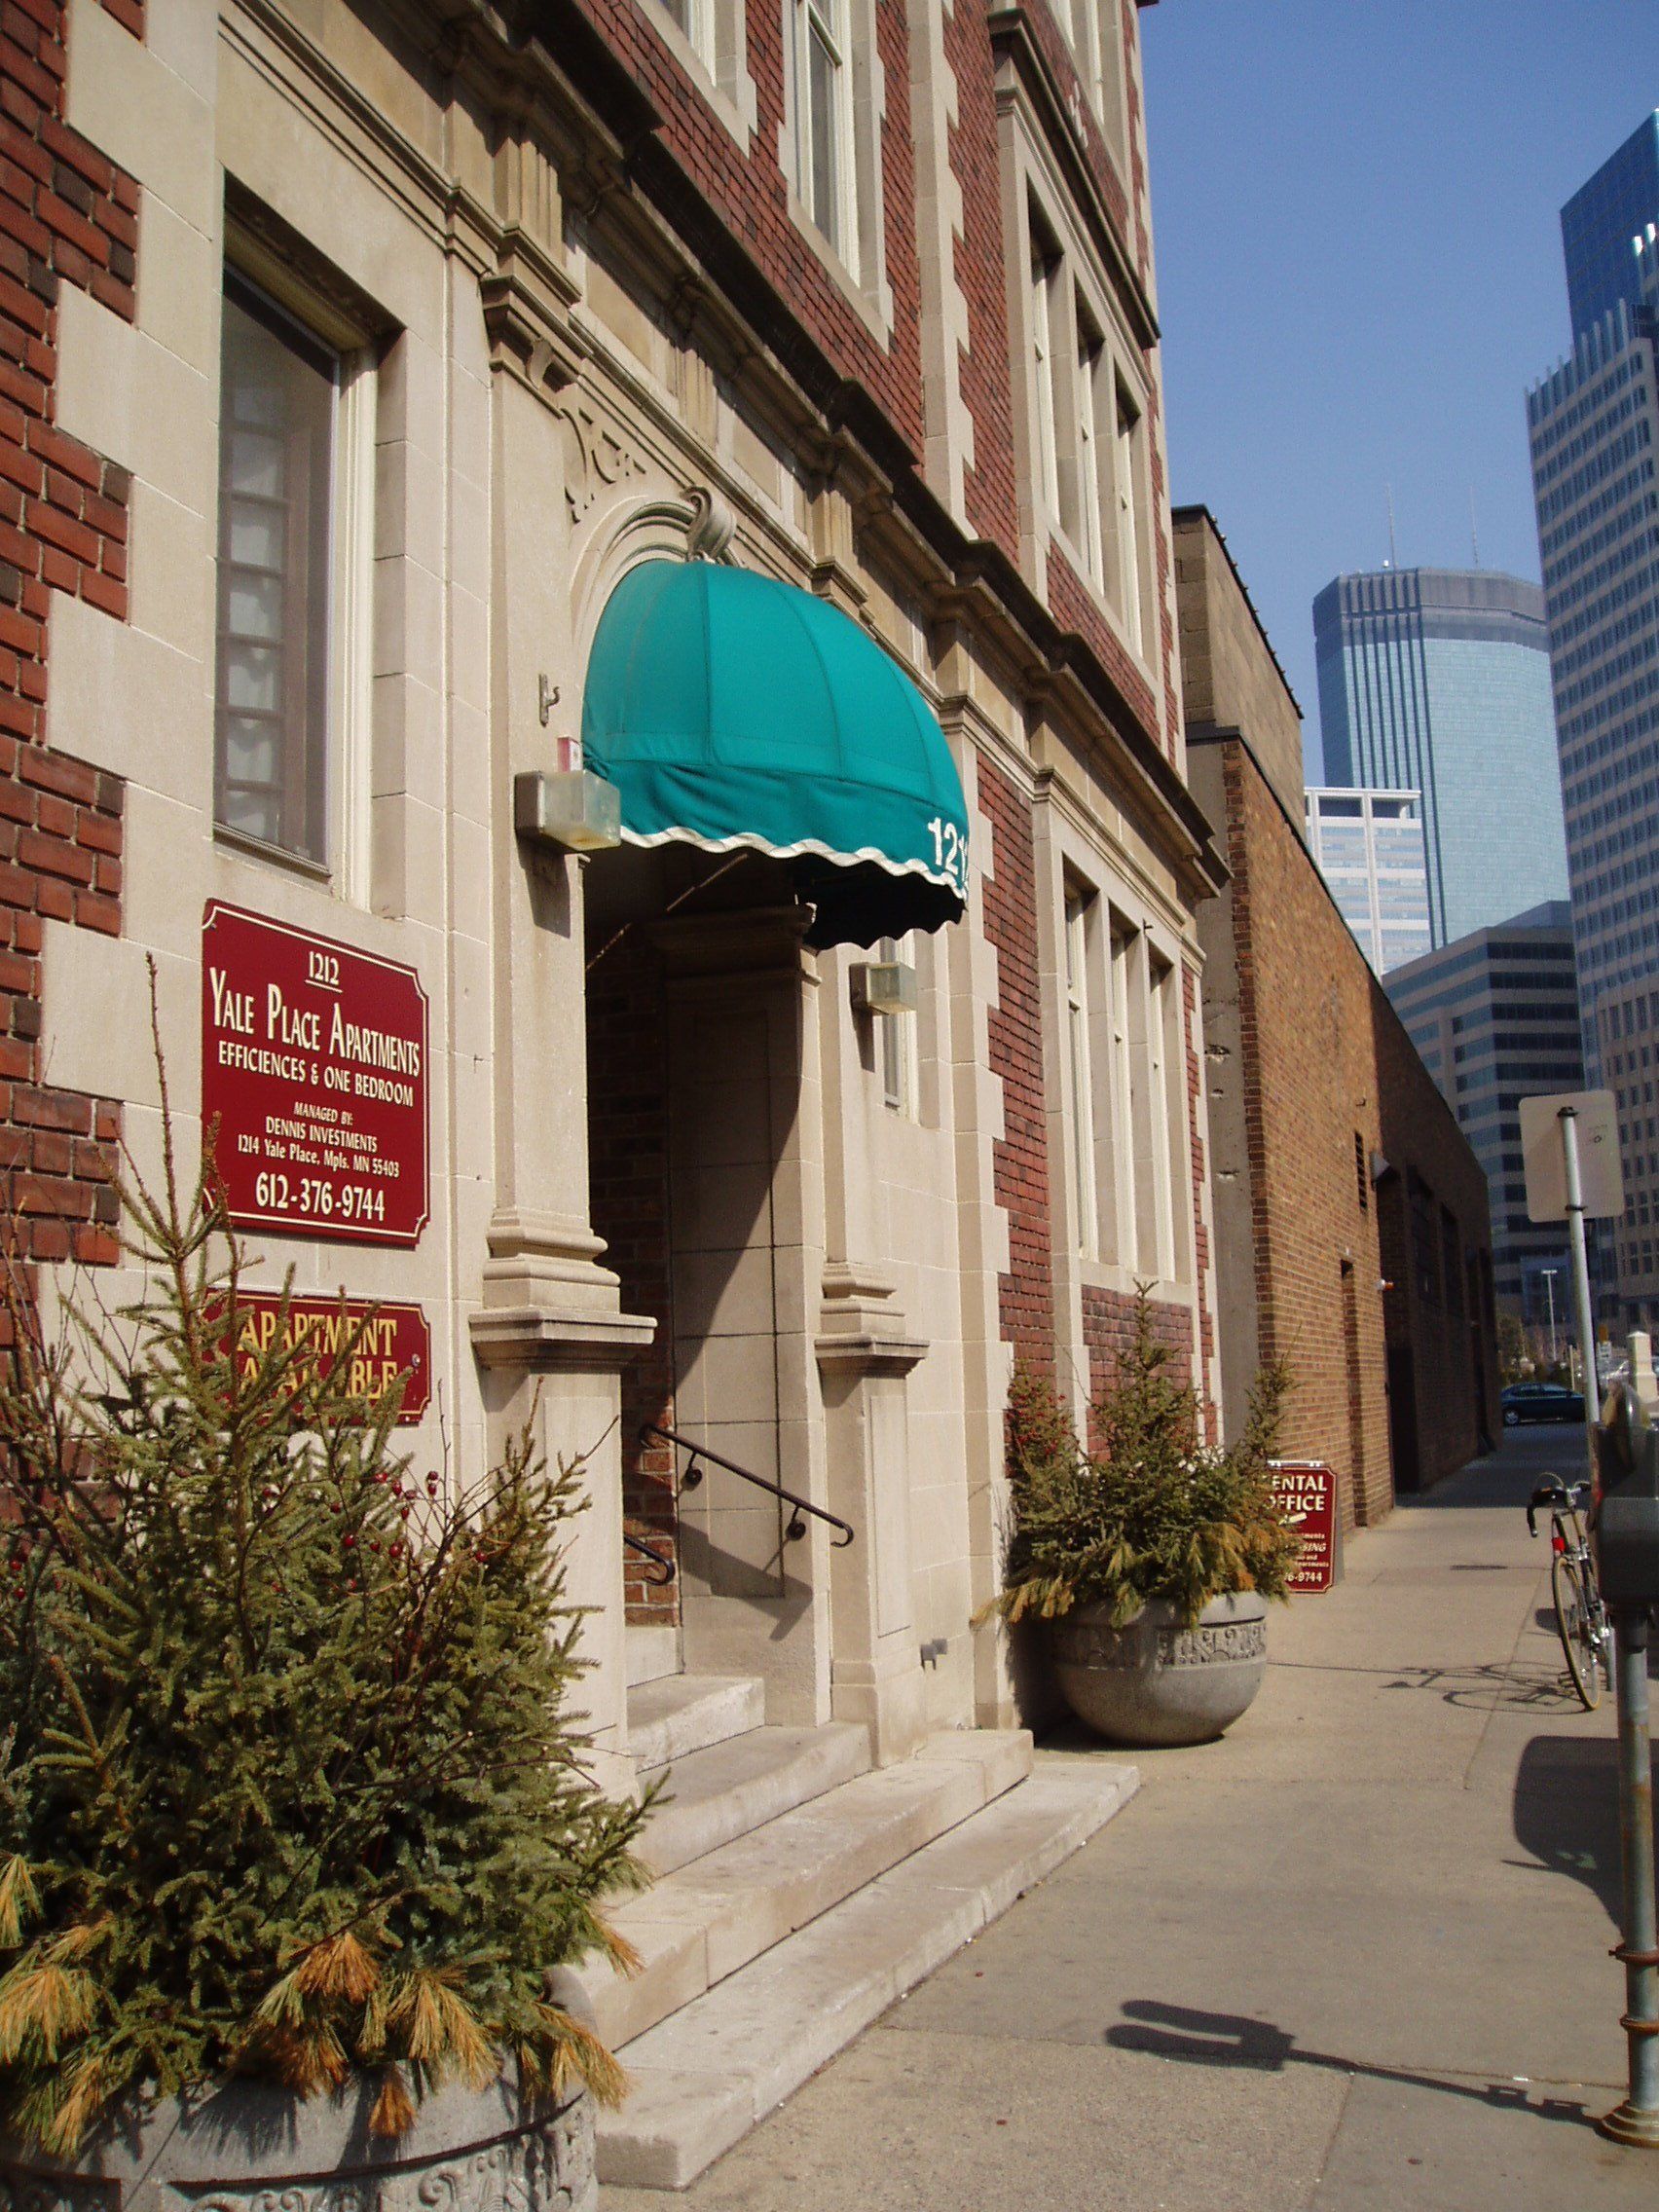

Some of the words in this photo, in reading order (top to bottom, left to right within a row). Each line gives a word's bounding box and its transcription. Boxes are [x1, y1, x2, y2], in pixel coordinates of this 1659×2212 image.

[309, 950, 340, 985] 1212
[218, 1040, 306, 1083] EFFICIENCES
[311, 1063, 318, 1086] &
[324, 1066, 350, 1092] ONE
[355, 1073, 414, 1107] BEDROOM
[294, 1101, 338, 1123] MANAGED
[266, 1116, 307, 1140] DENNIS
[310, 1124, 378, 1153] INVESTMENTS
[239, 1134, 260, 1155] 1214
[264, 1138, 286, 1159] Yale
[353, 1155, 370, 1173] MN
[373, 1159, 400, 1178] 55403
[255, 1171, 386, 1222] 612-376-9744
[1262, 1475, 1328, 1492] ENTAL
